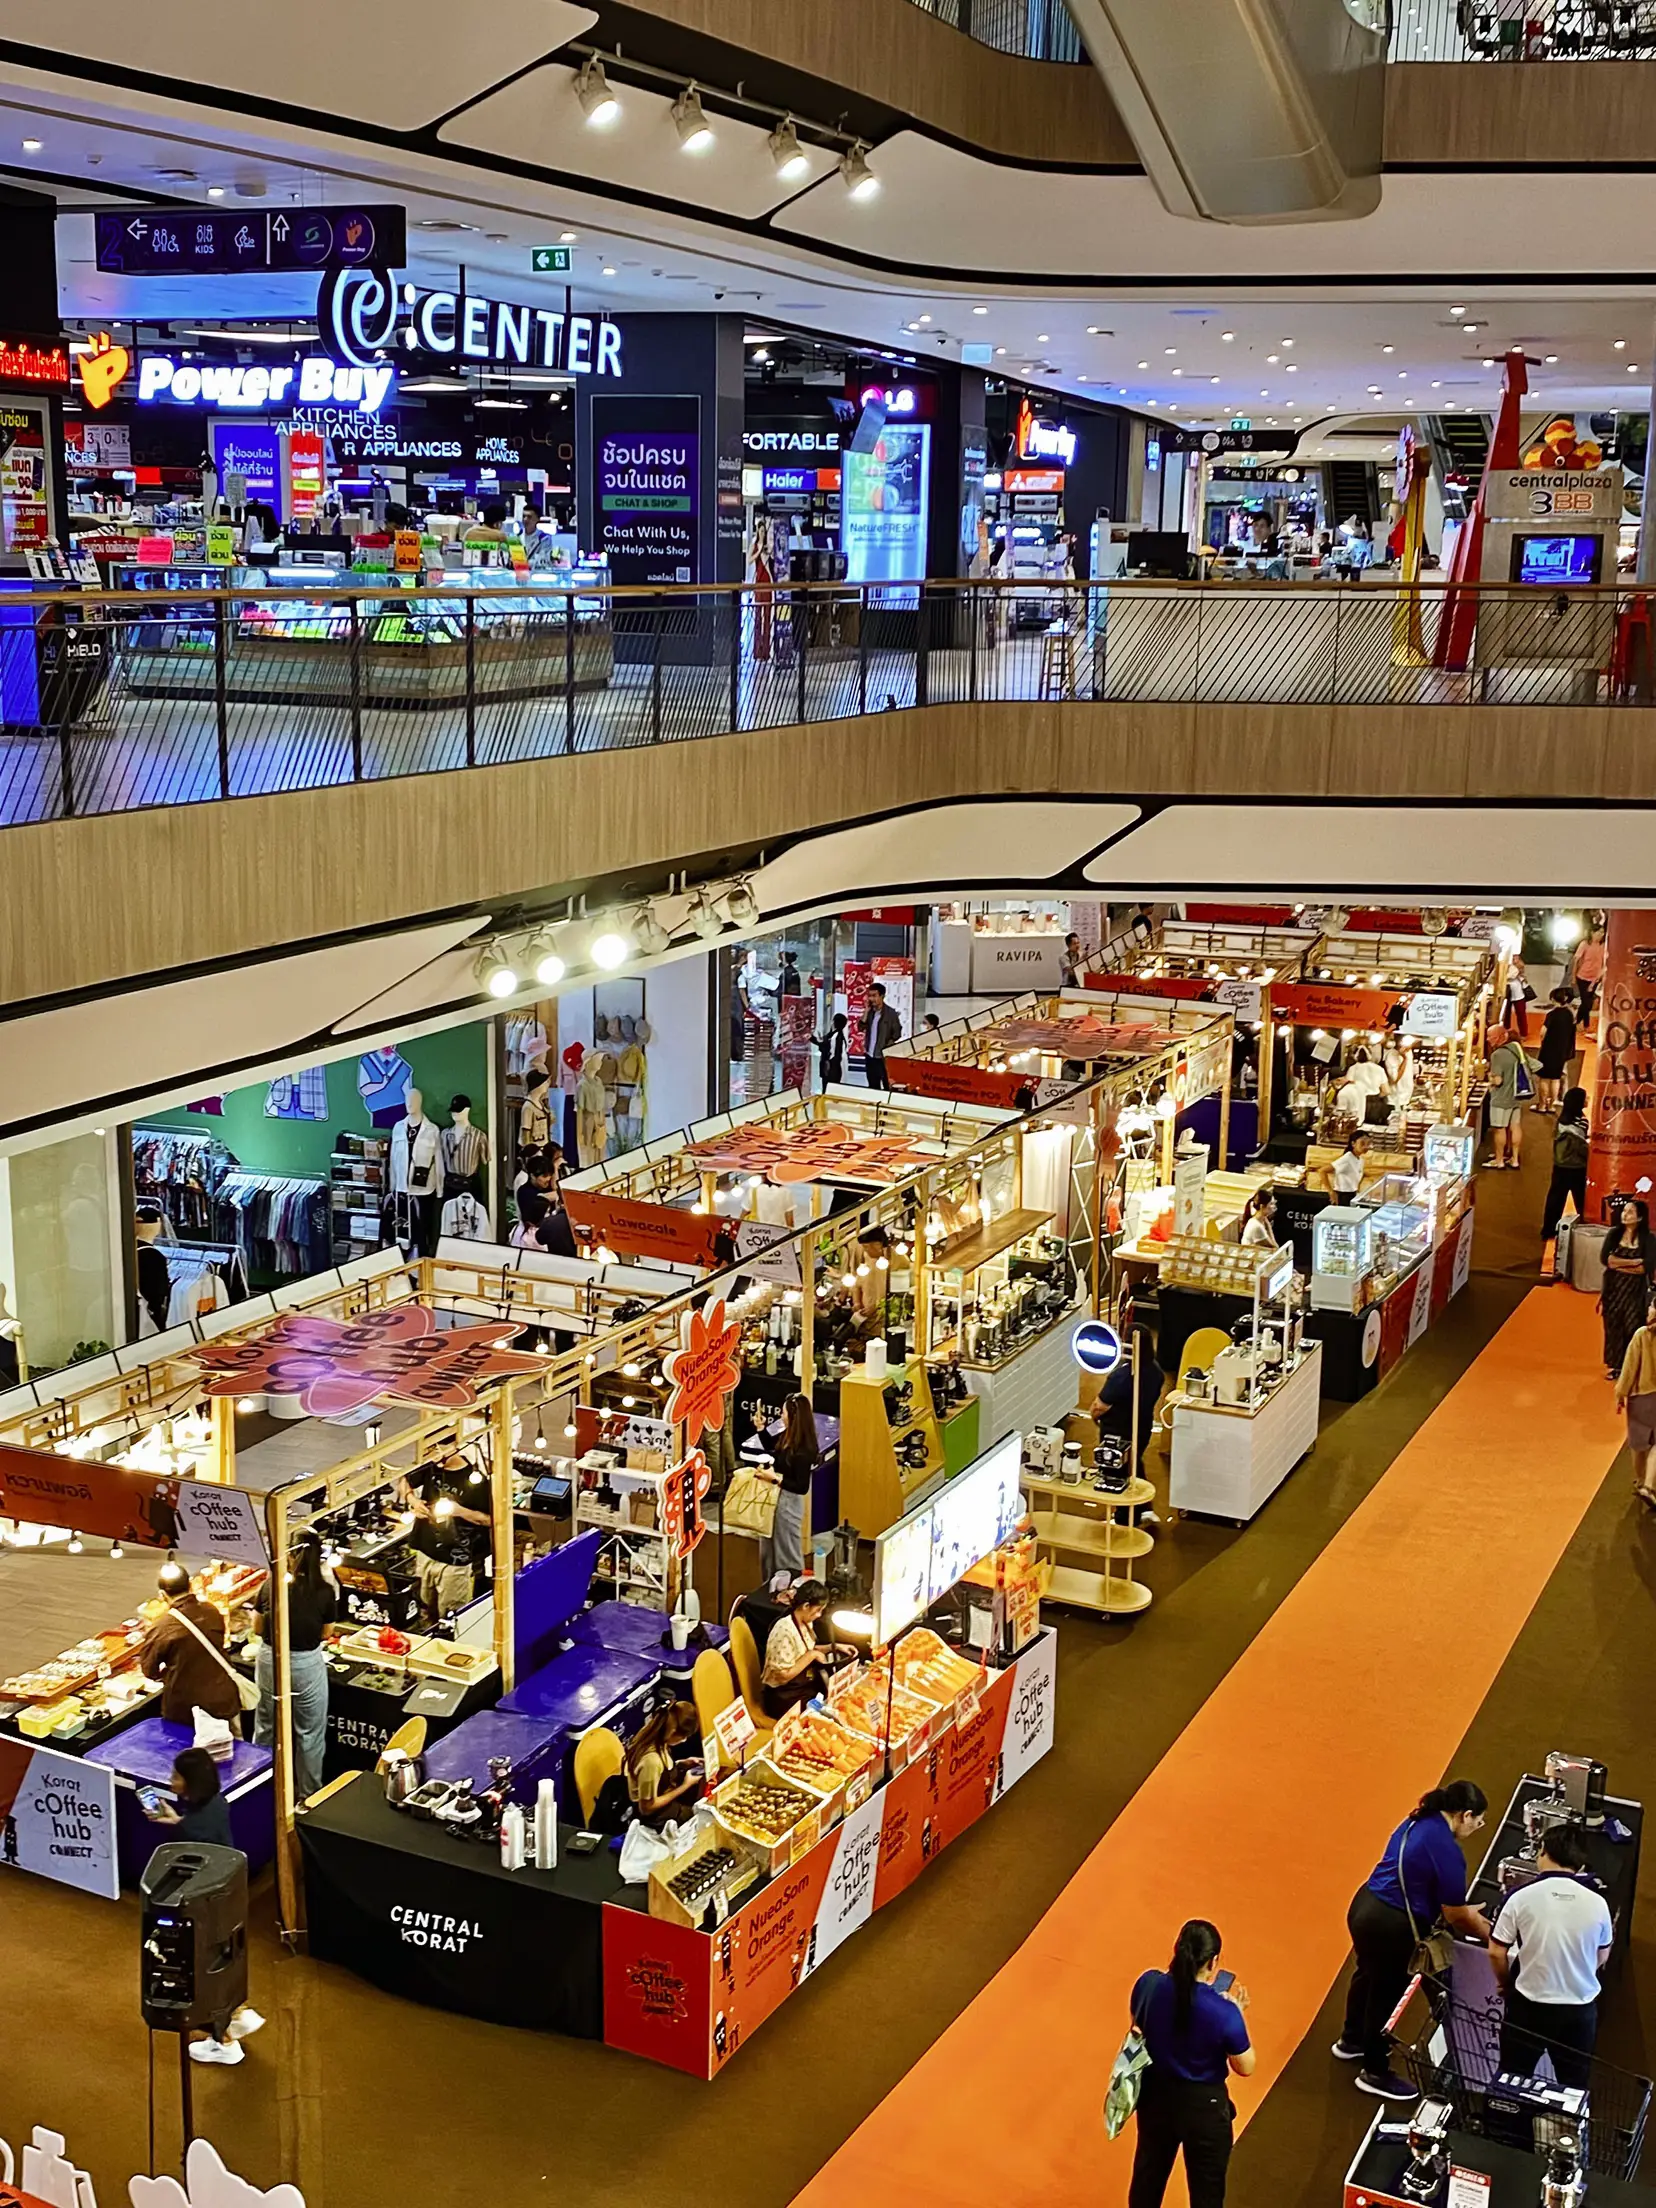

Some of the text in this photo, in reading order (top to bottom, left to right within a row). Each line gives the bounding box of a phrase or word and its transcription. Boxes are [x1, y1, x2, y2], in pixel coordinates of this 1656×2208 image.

[195, 244, 215, 254] KIDS
[139, 357, 394, 412] Power Buy
[292, 407, 381, 425] KITCHEN
[275, 421, 398, 440] APPLIANCES
[363, 440, 463, 458] APPLIANCES
[485, 437, 508, 449] HOME
[603, 440, 687, 466] ช้อปครบ
[475, 447, 520, 464] APPLIANCES
[604, 469, 687, 490] จบในแชต
[765, 471, 805, 489] Haier
[1508, 472, 1612, 492] centralplaza
[614, 498, 640, 508] CHAT
[651, 499, 678, 508] SHOP
[1528, 491, 1594, 515] 3BB
[603, 525, 691, 541] Chat With Us,
[603, 543, 691, 558] We Help You Shop
[996, 949, 1044, 964] RAVIPA
[1424, 1011, 1445, 1020] hub
[1044, 1089, 1066, 1099] cOff
[686, 1351, 726, 1394] Orange
[189, 1502, 243, 1517] cOffee
[205, 1517, 238, 1530] hub
[1014, 1673, 1050, 1726] cOffee
[327, 1714, 396, 1742] CENTRA
[1022, 1700, 1044, 1736] hub
[949, 1735, 986, 1777] Orange
[41, 1773, 81, 1793] Korat
[34, 1793, 103, 1820] cOffee
[52, 1816, 92, 1840] hub
[834, 1831, 880, 1892] cOffee
[844, 1861, 870, 1901] hub
[749, 1874, 810, 1938] NueaSom
[390, 1905, 484, 1939] CENTRAL
[401, 1928, 468, 1953] KORAT
[747, 1908, 795, 1959] Orange
